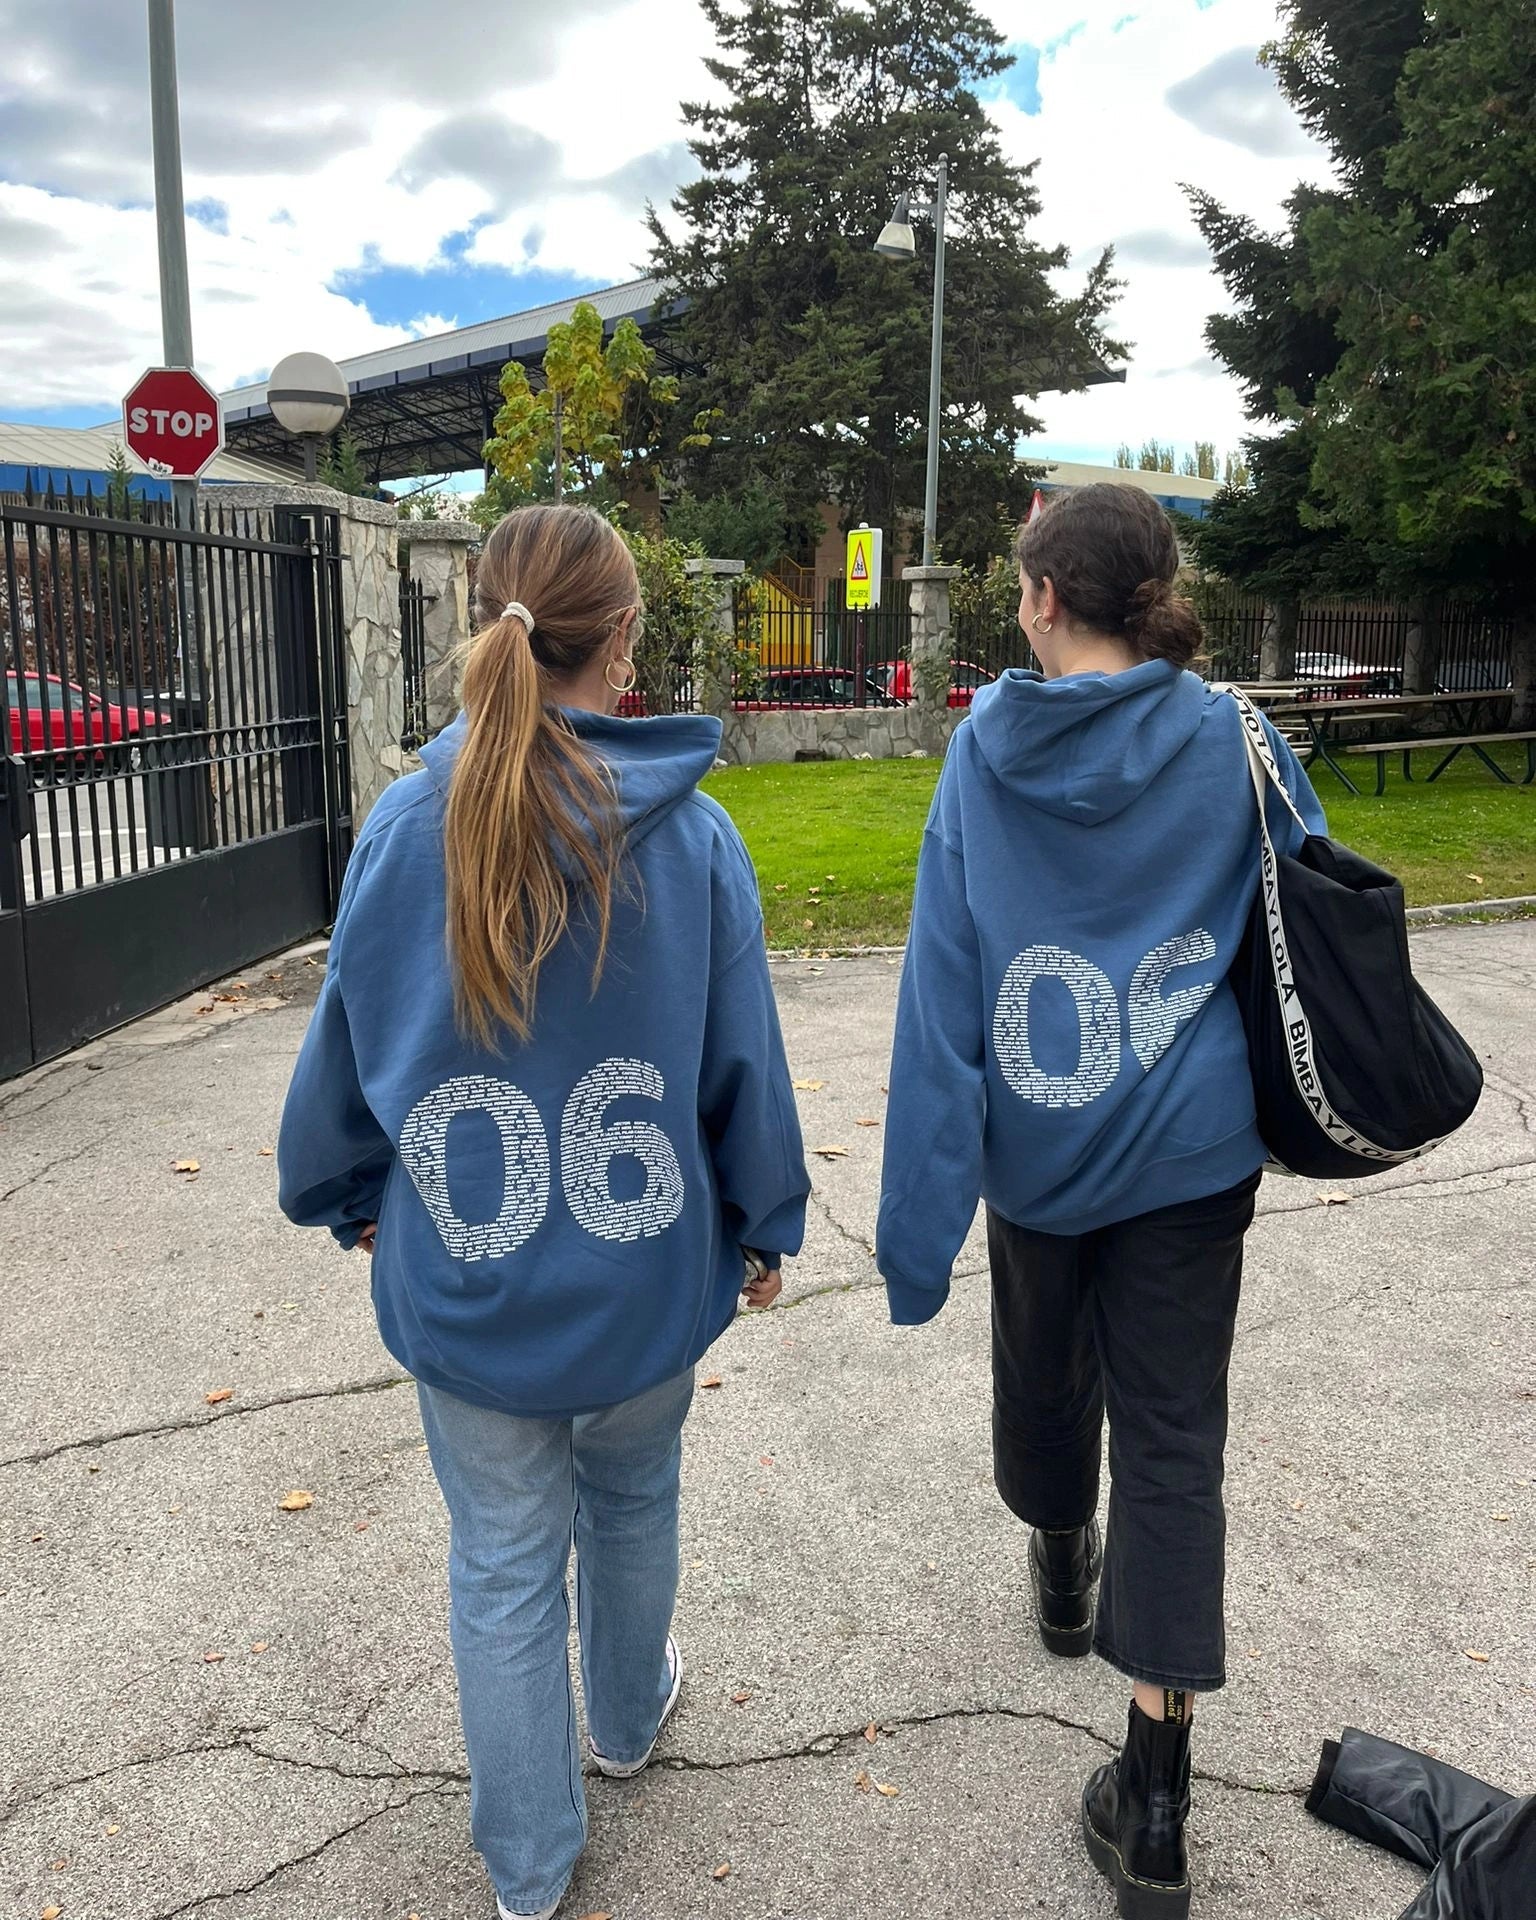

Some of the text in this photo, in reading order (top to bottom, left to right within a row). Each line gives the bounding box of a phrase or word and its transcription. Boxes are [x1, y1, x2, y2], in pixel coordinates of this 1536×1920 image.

[129, 407, 213, 438] STOP
[1271, 925, 1297, 1004] LOLA
[399, 1056, 685, 1262] 06
